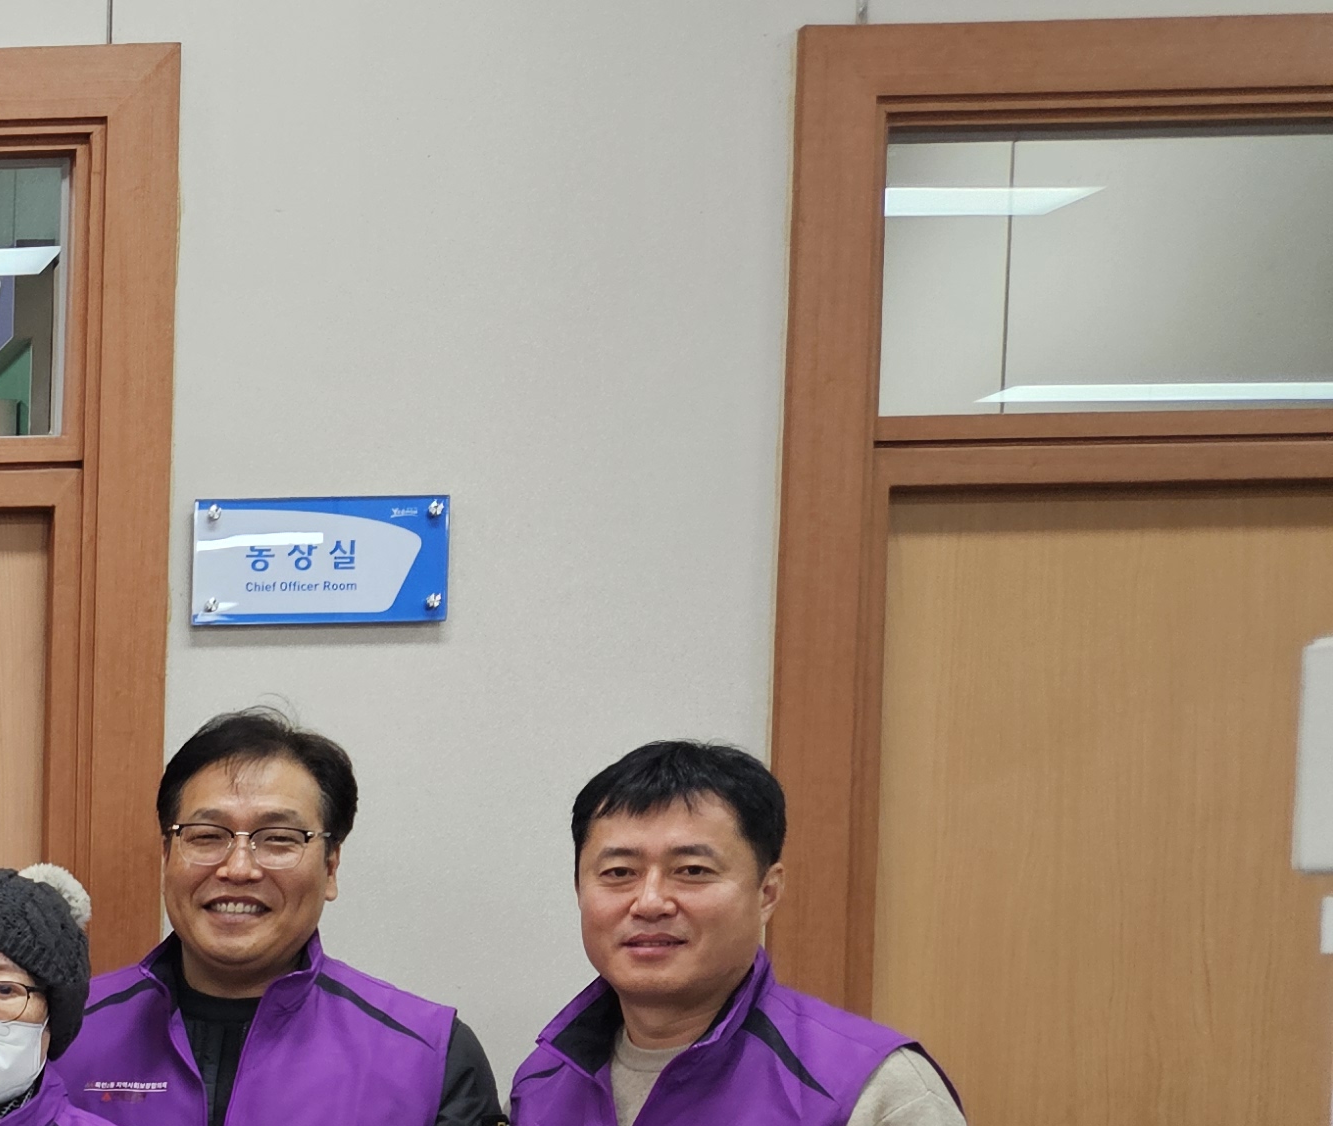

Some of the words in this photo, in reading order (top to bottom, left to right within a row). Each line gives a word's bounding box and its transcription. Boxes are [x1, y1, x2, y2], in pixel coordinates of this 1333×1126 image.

[245, 582, 276, 592] Chief
[280, 581, 318, 592] Officer
[323, 581, 357, 592] Room
